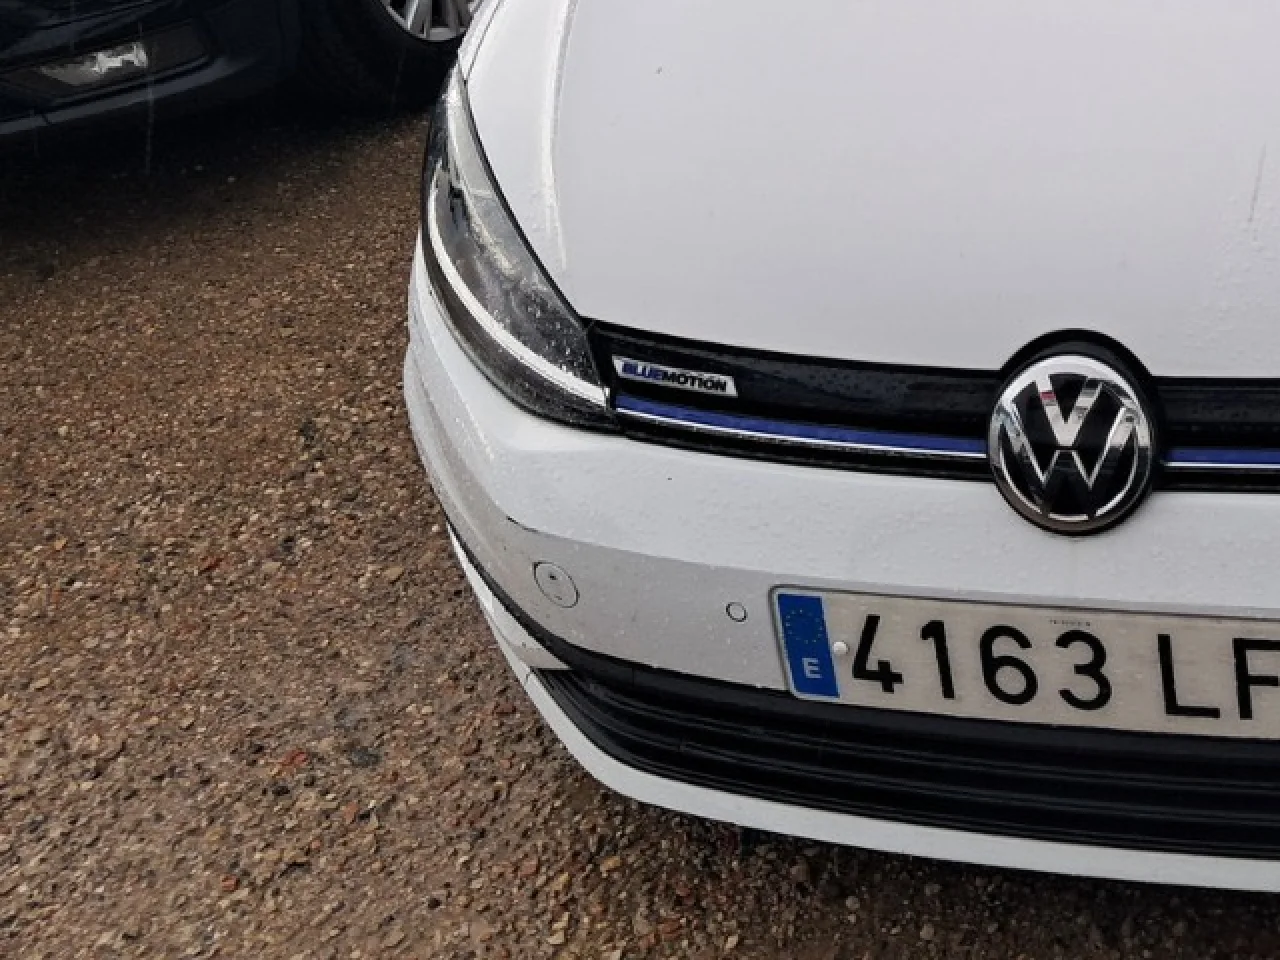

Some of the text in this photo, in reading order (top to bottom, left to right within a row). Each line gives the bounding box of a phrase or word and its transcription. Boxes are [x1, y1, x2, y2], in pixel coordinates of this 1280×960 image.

[622, 361, 727, 391] BLUEMOTION
[801, 657, 823, 679] E
[851, 614, 1113, 711] 4163
